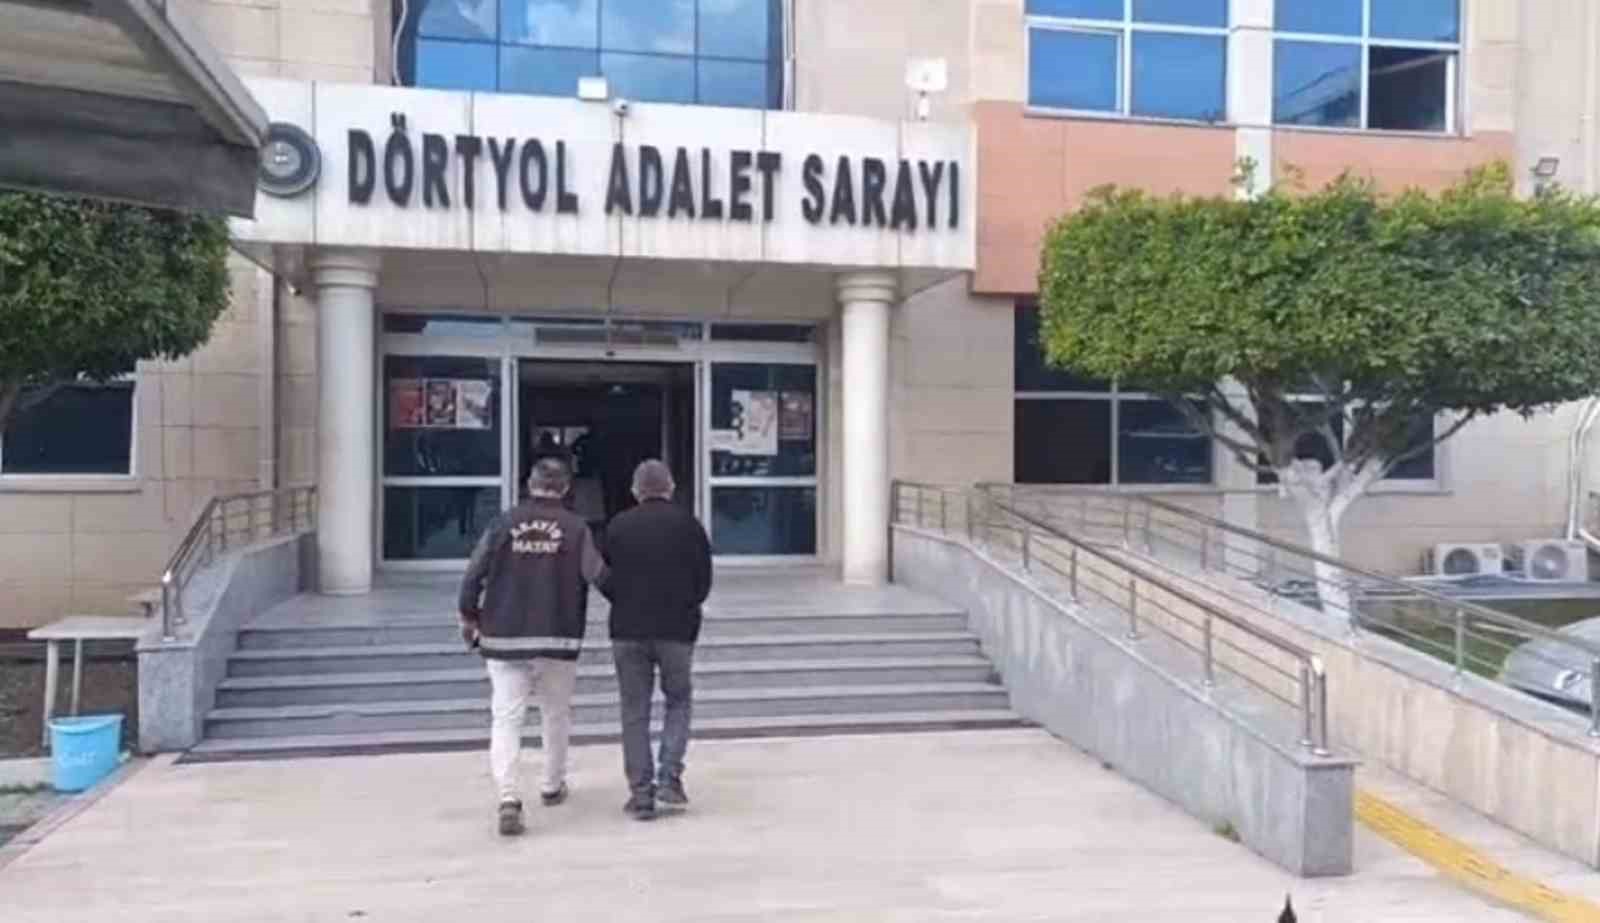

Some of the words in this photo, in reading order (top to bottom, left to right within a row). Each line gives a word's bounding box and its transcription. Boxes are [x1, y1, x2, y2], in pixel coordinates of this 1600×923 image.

[348, 112, 579, 215] DÖRTYOL
[604, 142, 782, 223] ADALET
[801, 153, 960, 230] SARAYI
[511, 540, 561, 553] HATAY
